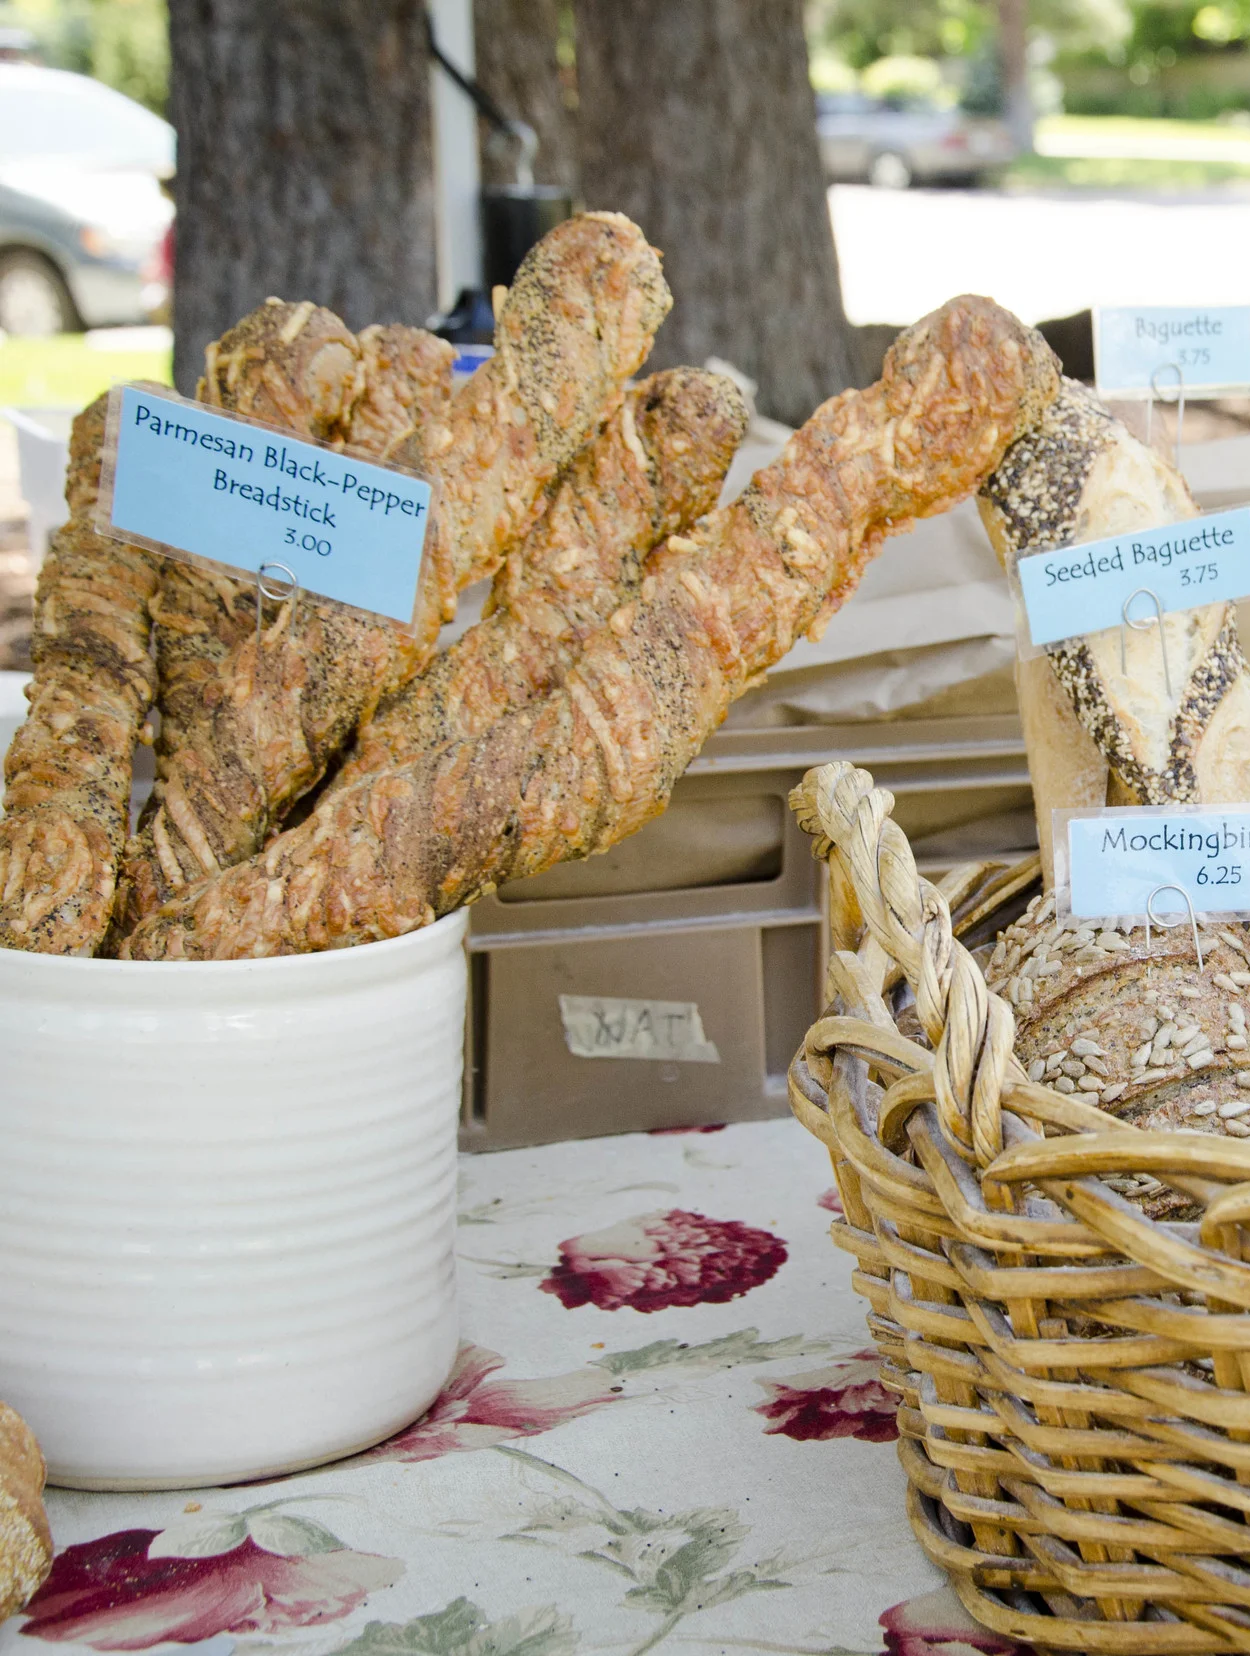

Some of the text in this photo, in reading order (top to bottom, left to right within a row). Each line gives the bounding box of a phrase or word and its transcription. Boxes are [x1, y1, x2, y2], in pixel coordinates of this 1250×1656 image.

[1135, 316, 1224, 344] Baguette
[1177, 348, 1212, 366] 3.75
[135, 404, 426, 518] Parmesan Black-Pepper
[213, 468, 337, 528] Breadstick
[283, 527, 332, 557] 3.00
[1044, 526, 1235, 587] Seeded Baguette
[1180, 563, 1219, 587] 3.75
[1195, 865, 1242, 886] 6.25
